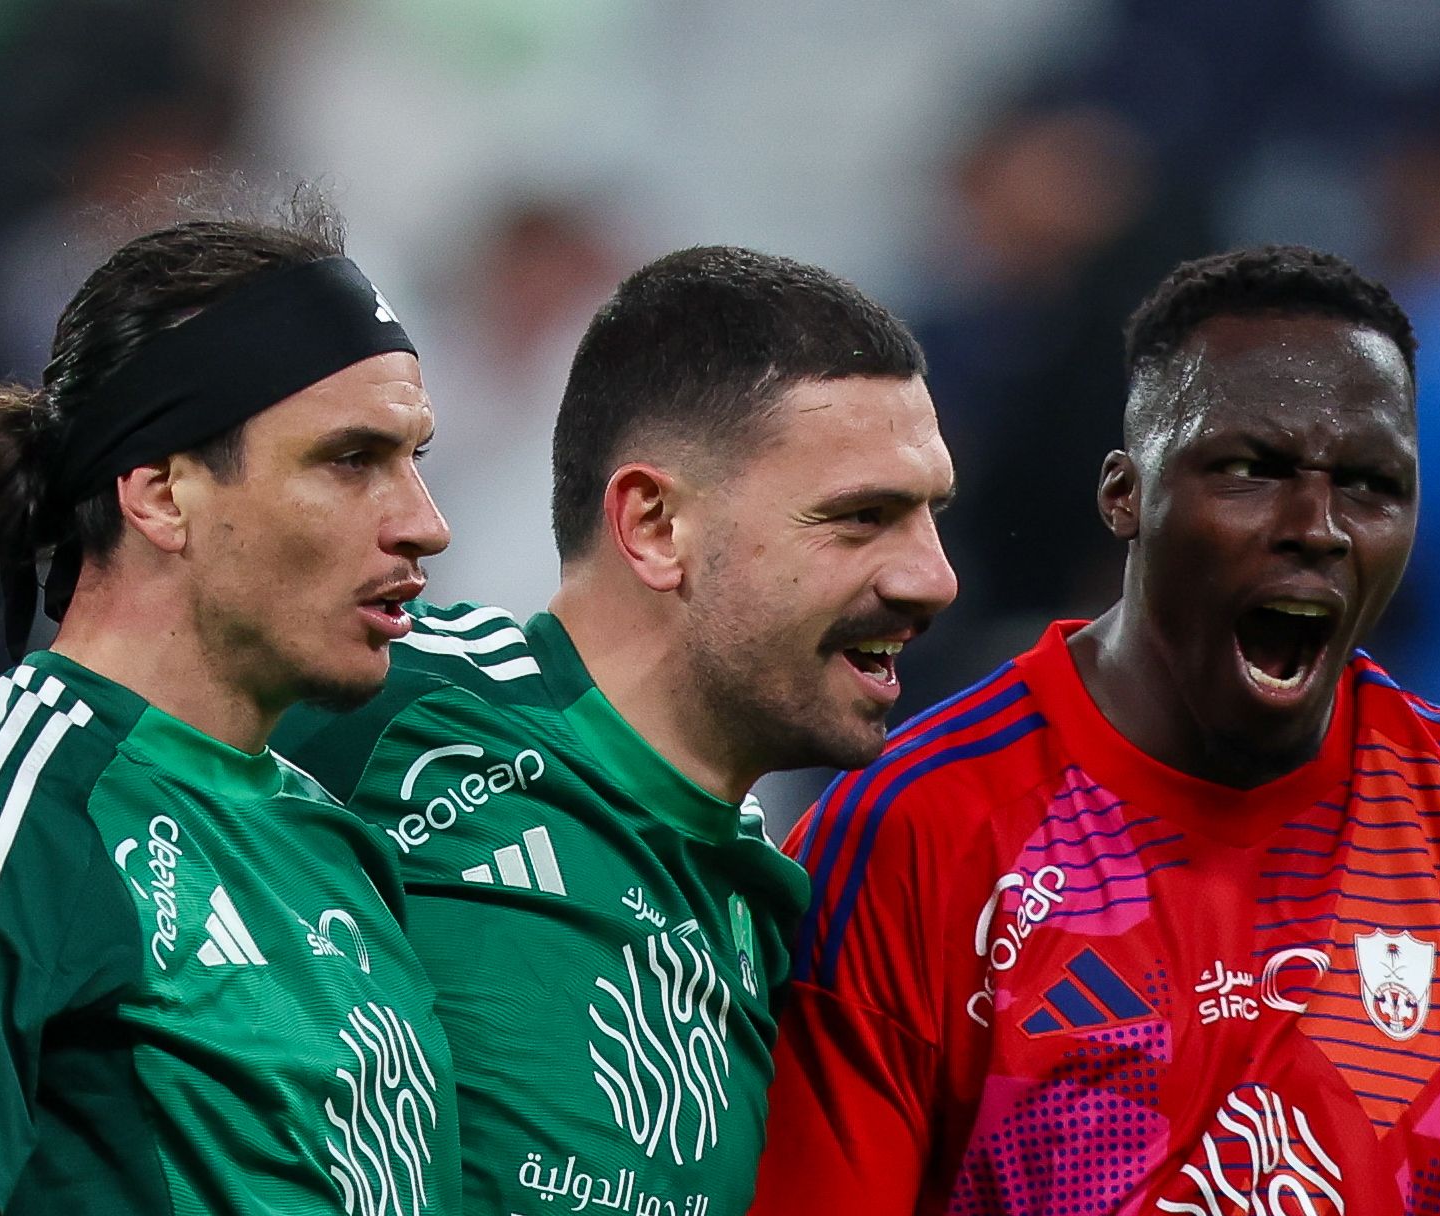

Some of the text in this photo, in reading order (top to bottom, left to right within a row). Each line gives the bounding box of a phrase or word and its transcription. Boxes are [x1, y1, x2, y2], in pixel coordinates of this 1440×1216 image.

[1194, 960, 1253, 995] سرك
[1198, 994, 1260, 1025] SIRC
[517, 1151, 635, 1212] الدولية
